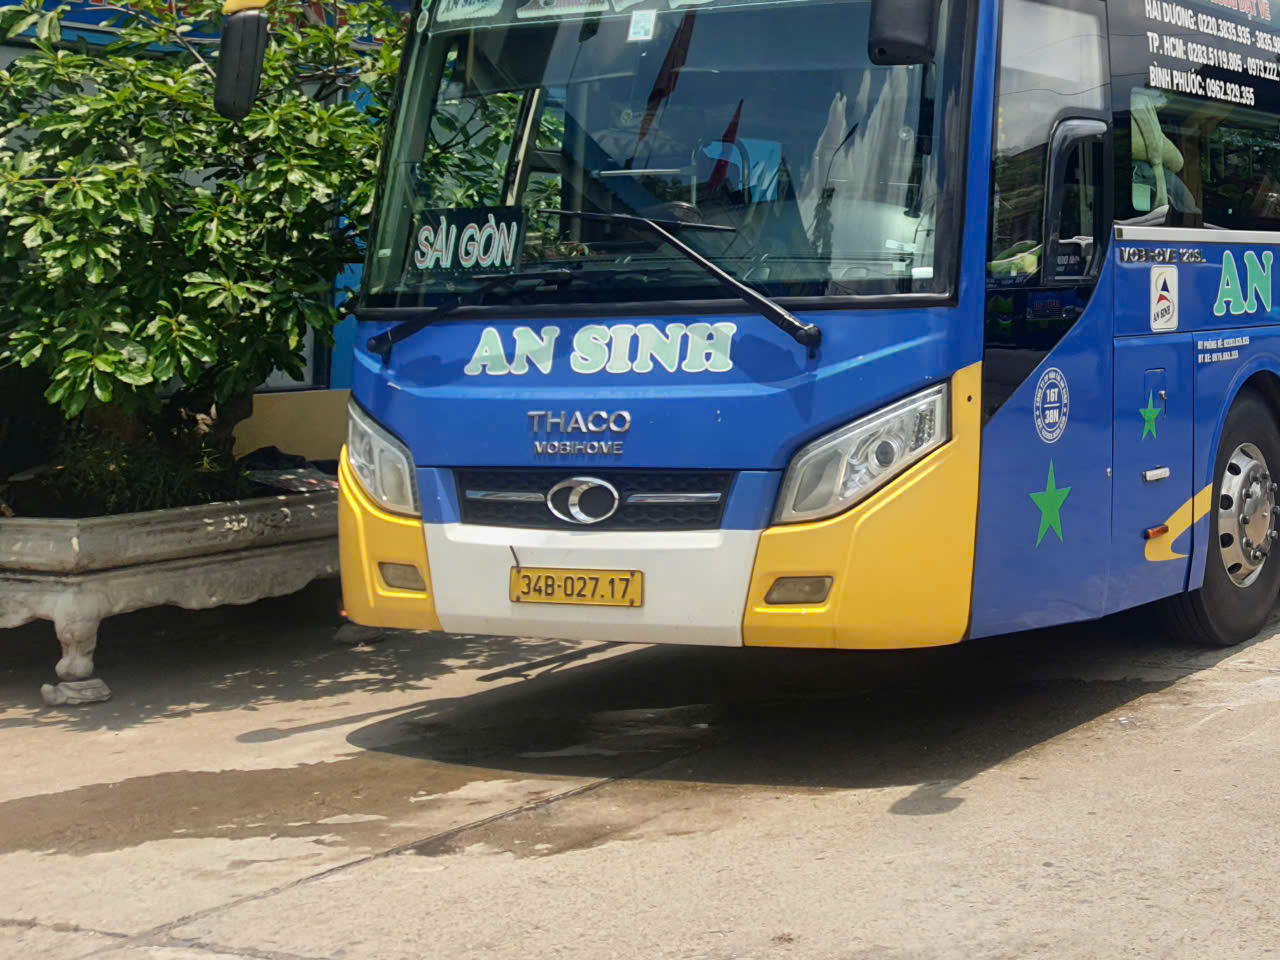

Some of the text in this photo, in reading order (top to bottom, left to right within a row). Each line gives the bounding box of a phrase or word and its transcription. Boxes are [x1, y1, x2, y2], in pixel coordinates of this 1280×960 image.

[1163, 2, 1198, 30] DƯƠNG:
[1163, 36, 1186, 60] HCM:
[1149, 61, 1172, 89] BÌNH
[1173, 68, 1206, 95] PHƯỚC:
[414, 213, 517, 269] SÀI GÒN
[1213, 250, 1273, 316] AN
[464, 322, 738, 376] AN SINH
[527, 410, 632, 434] THACO
[533, 440, 624, 456] MOBIHOME
[520, 573, 631, 601] 34B-027.17
